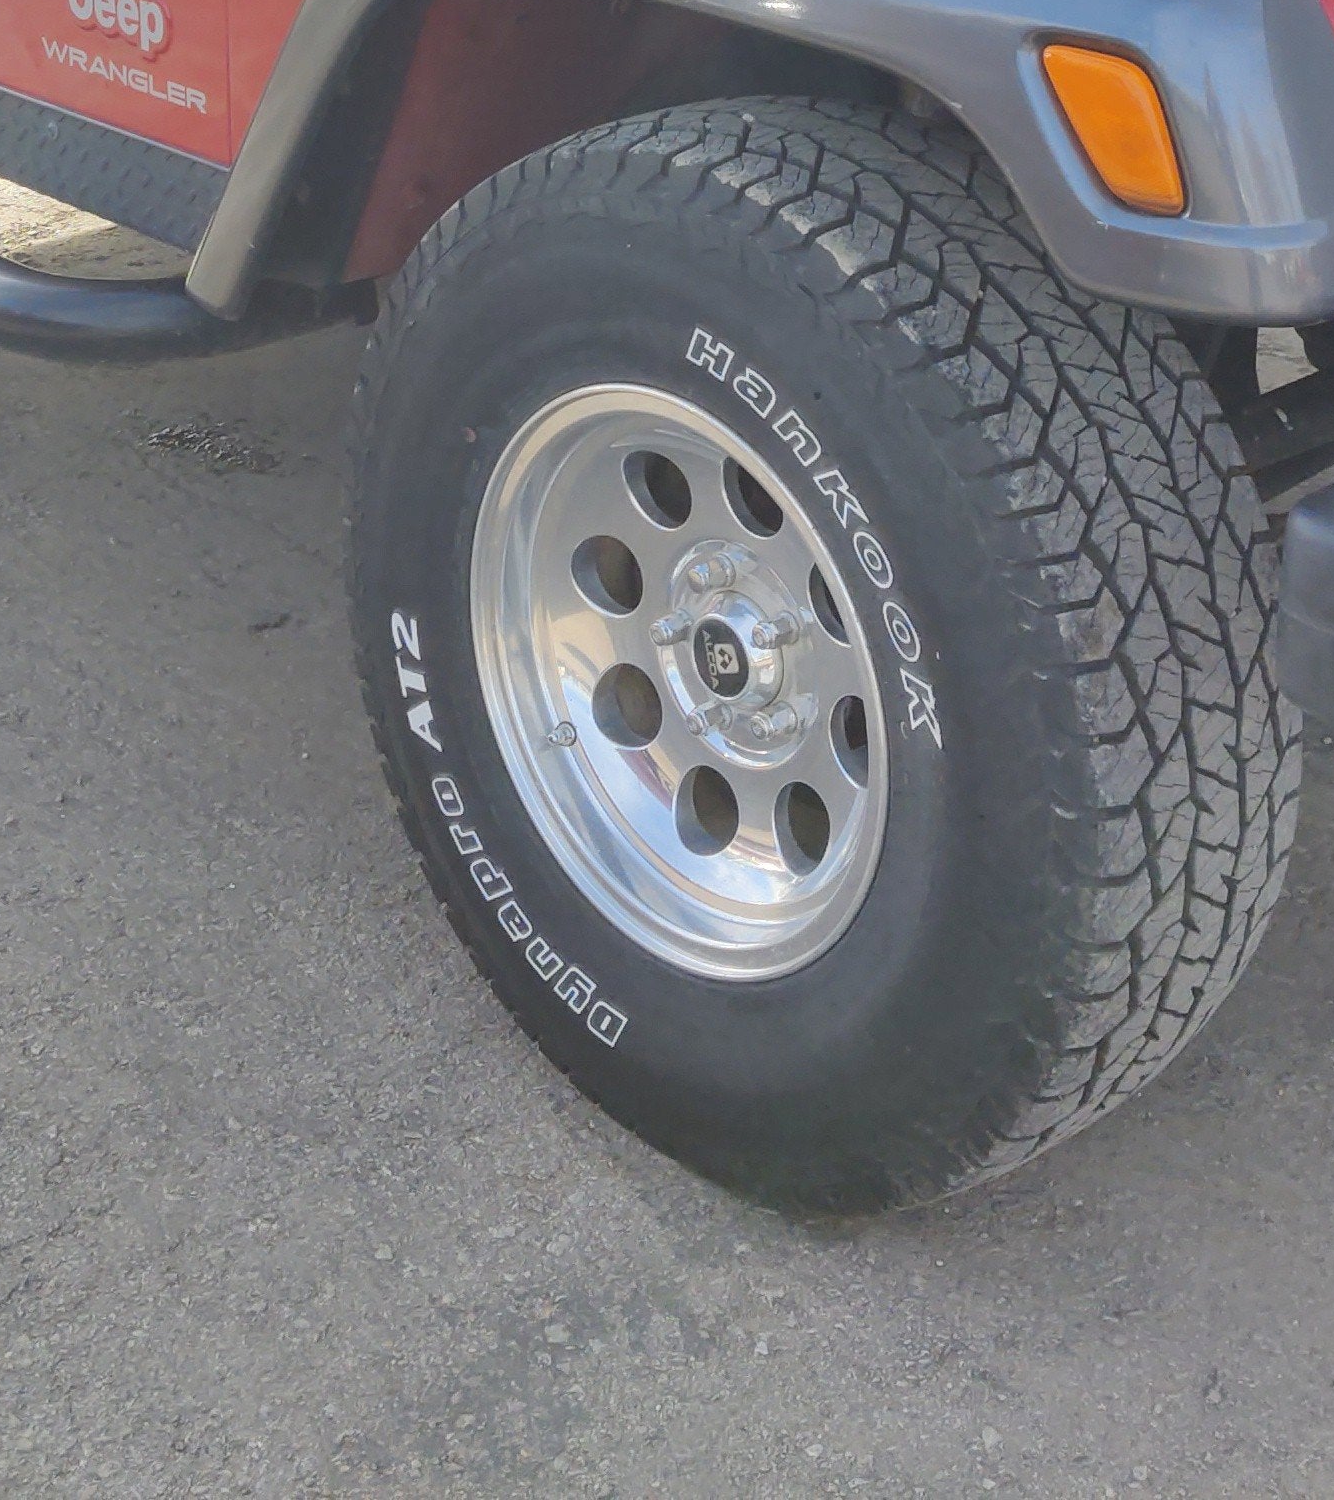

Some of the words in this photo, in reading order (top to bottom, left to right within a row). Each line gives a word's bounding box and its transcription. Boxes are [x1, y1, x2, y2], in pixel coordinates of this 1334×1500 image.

[41, 36, 208, 114] WRANGLER
[391, 609, 443, 753] AT2
[701, 629, 719, 690] ALCOA
